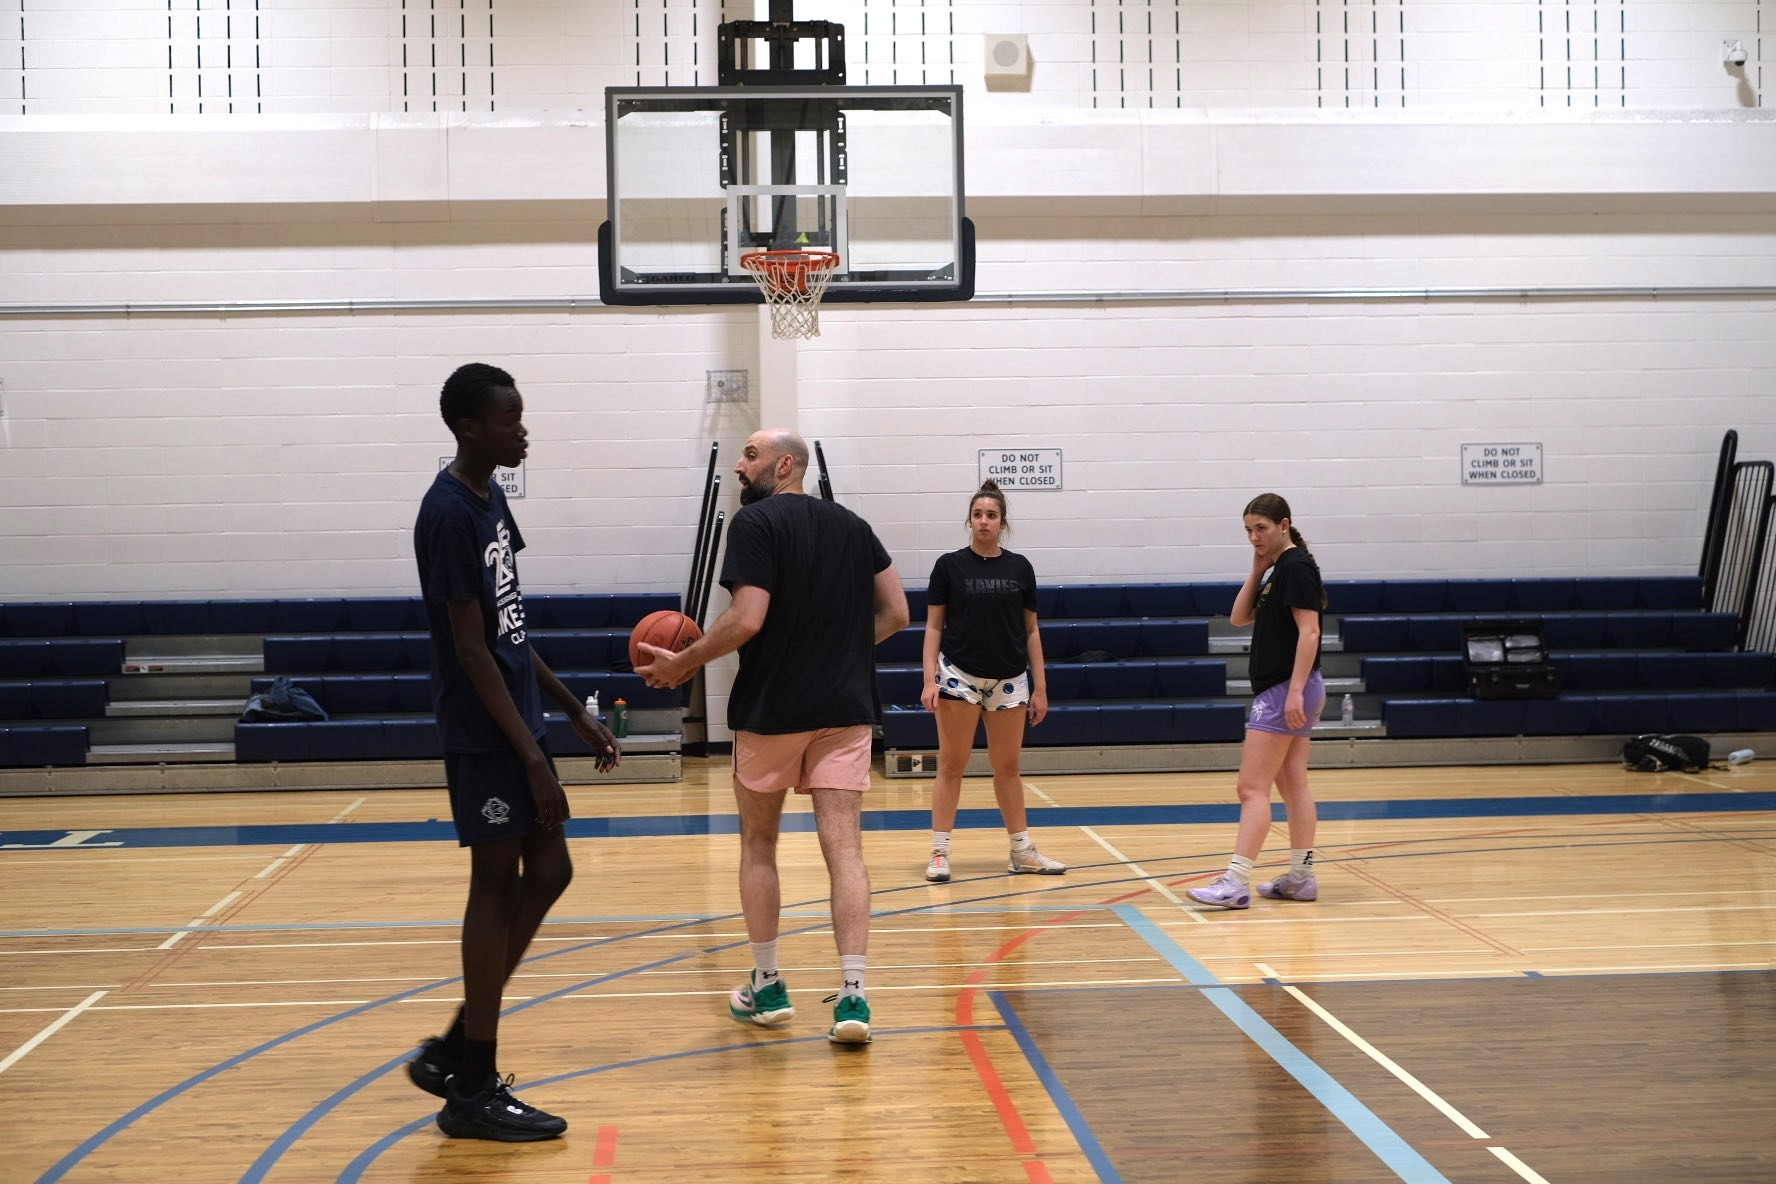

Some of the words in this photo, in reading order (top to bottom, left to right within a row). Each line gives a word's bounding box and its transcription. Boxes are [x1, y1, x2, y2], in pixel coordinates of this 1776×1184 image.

[1484, 448, 1497, 456] DO
[1502, 448, 1520, 456] NOT
[1001, 454, 1016, 462] DO
[1020, 454, 1039, 462] NOT
[1471, 460, 1499, 468] CLIMB
[1503, 459, 1516, 467] OR
[1520, 459, 1533, 467] SIT
[989, 466, 1017, 474] CLIMB
[1022, 465, 1035, 473] OR
[1039, 465, 1052, 473] SIT
[501, 473, 515, 481] SIT
[1469, 471, 1497, 479] WHEN
[1501, 470, 1536, 478] CLOSED
[1020, 477, 1055, 485] CLOSED
